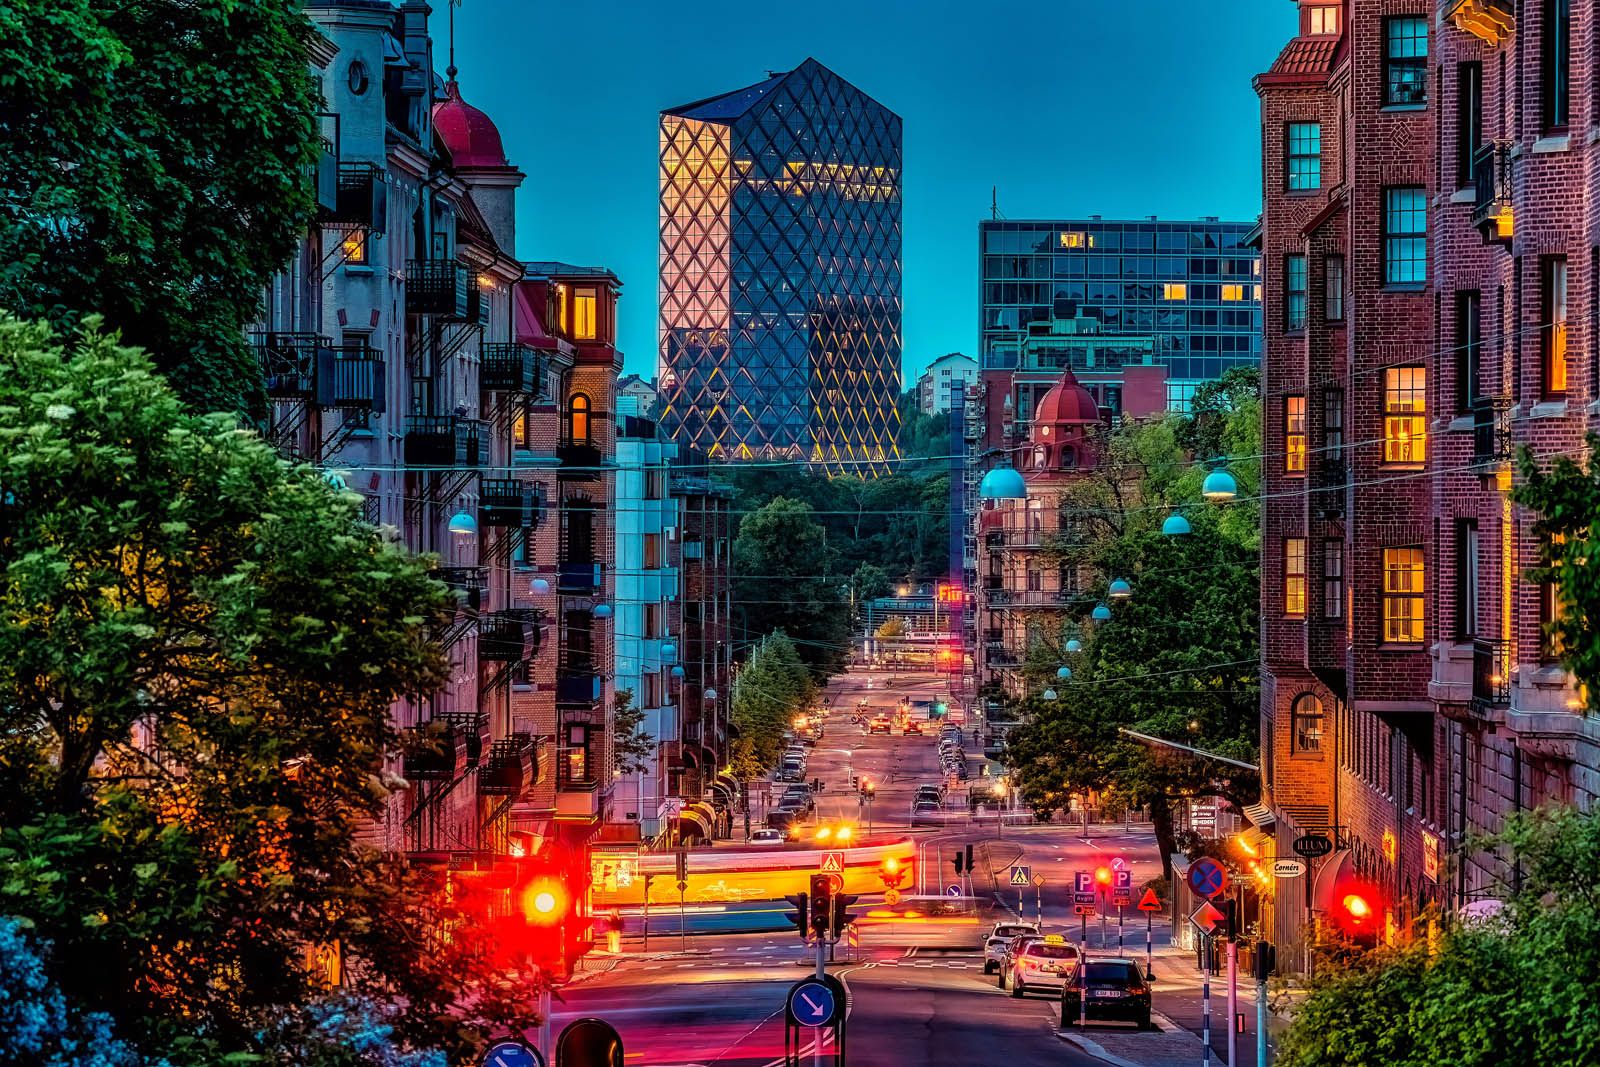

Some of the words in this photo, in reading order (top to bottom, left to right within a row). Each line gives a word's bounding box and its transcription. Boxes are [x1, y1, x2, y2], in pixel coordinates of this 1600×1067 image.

[1297, 840, 1328, 850] ILLUM
[1080, 873, 1091, 890] P
[1118, 872, 1128, 885] P
